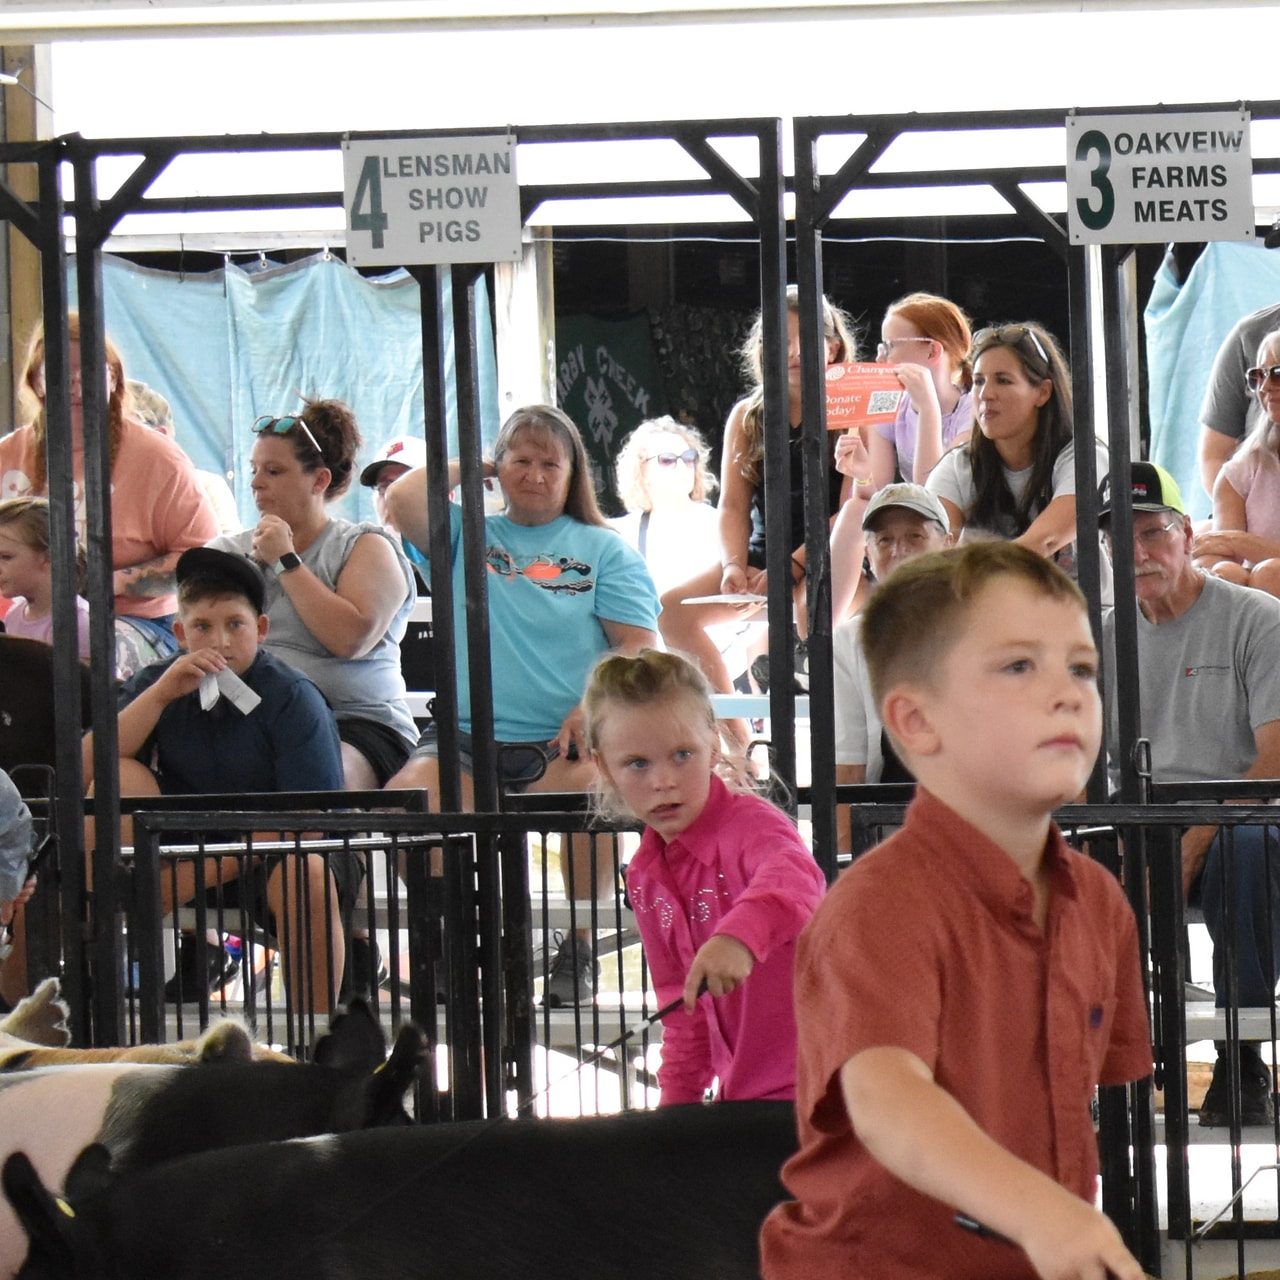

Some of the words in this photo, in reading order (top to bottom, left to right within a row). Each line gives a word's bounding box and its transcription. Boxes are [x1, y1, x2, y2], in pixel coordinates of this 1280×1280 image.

[1114, 130, 1243, 155] OAKVEIW
[382, 152, 511, 178] LENSMAN
[1132, 165, 1227, 188] FARMS
[1075, 130, 1115, 230] 3
[351, 155, 388, 249] 4
[408, 187, 488, 211] SHOW
[1134, 199, 1228, 222] MEATS
[419, 220, 481, 243] PIGS
[557, 344, 586, 411] ARBY
[826, 406, 856, 417] oday!
